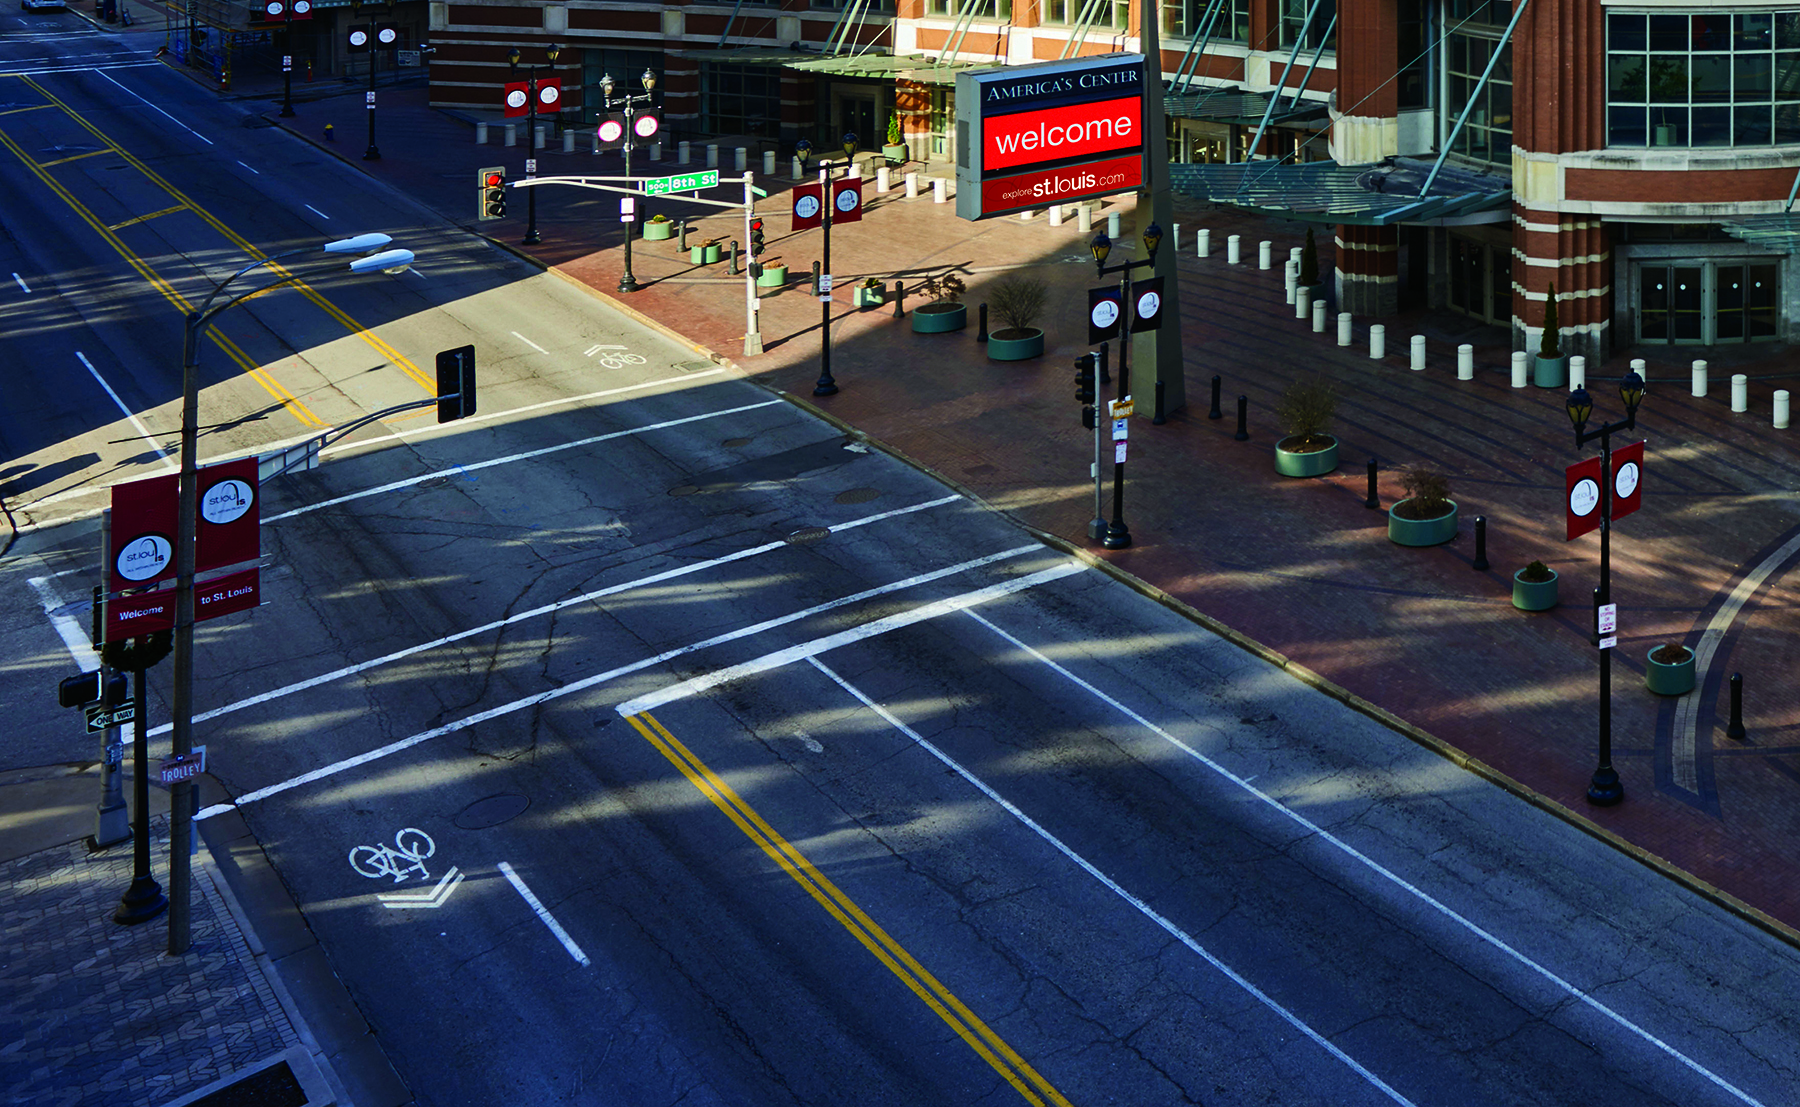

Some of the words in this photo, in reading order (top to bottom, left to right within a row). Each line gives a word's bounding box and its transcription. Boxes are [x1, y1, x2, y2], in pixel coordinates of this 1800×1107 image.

[986, 77, 1073, 102] AMERICA'S
[1079, 70, 1138, 88] CENTER
[995, 116, 1132, 155] welcome
[672, 177, 696, 189] 8th
[701, 174, 716, 185] St
[201, 596, 211, 605] to
[213, 591, 226, 602] St.
[228, 586, 253, 599] Louis
[119, 606, 164, 621] Welcome
[96, 713, 113, 726] ONE
[116, 708, 134, 720] WAY
[162, 763, 200, 782] TROLLEY
